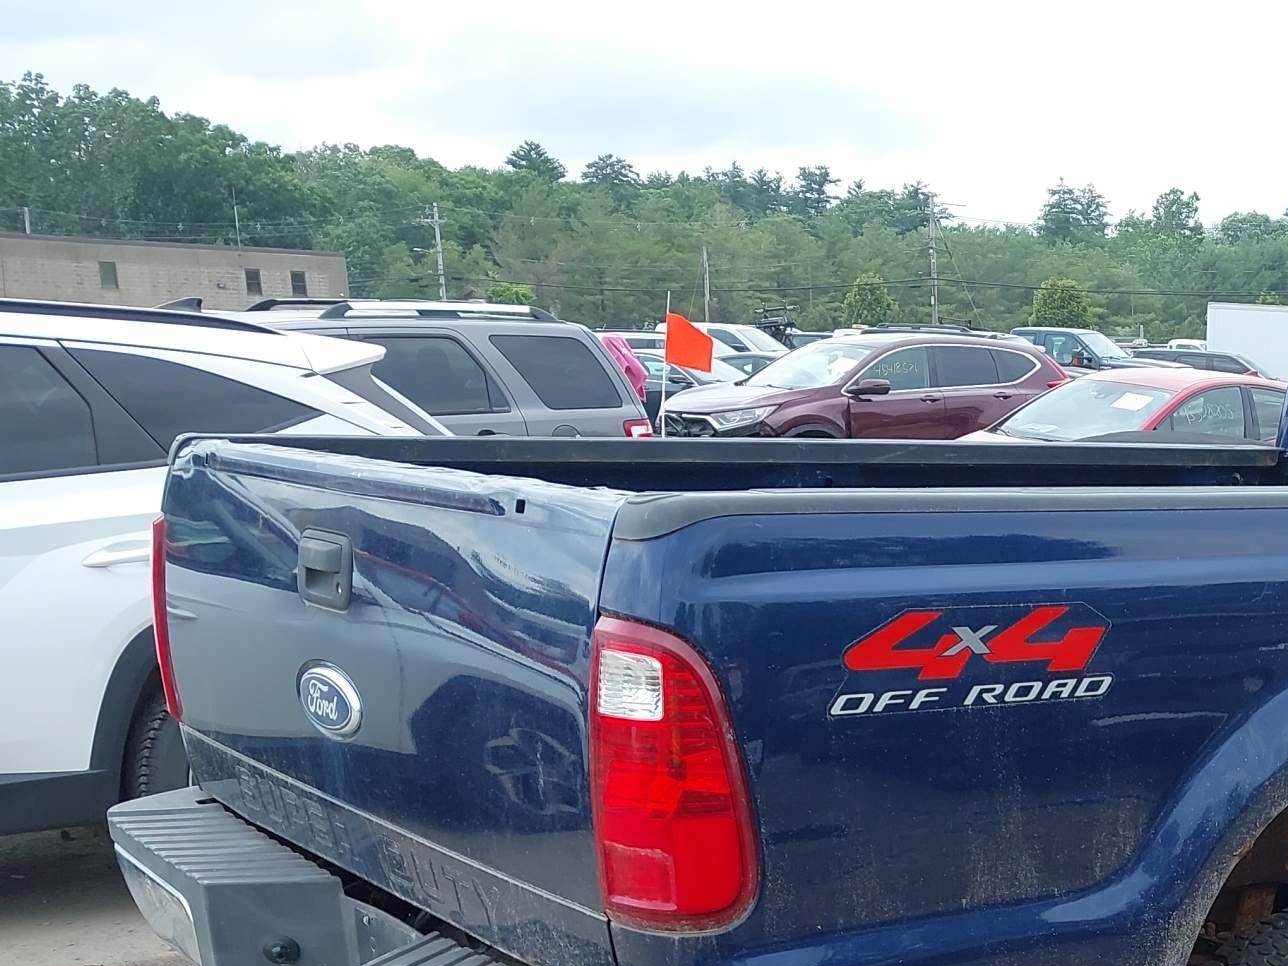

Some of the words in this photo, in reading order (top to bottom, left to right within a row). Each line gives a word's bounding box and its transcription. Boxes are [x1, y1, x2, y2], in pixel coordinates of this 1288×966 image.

[307, 679, 338, 721] Ford
[830, 688, 949, 715] OFF
[963, 675, 1113, 706] ROAD
